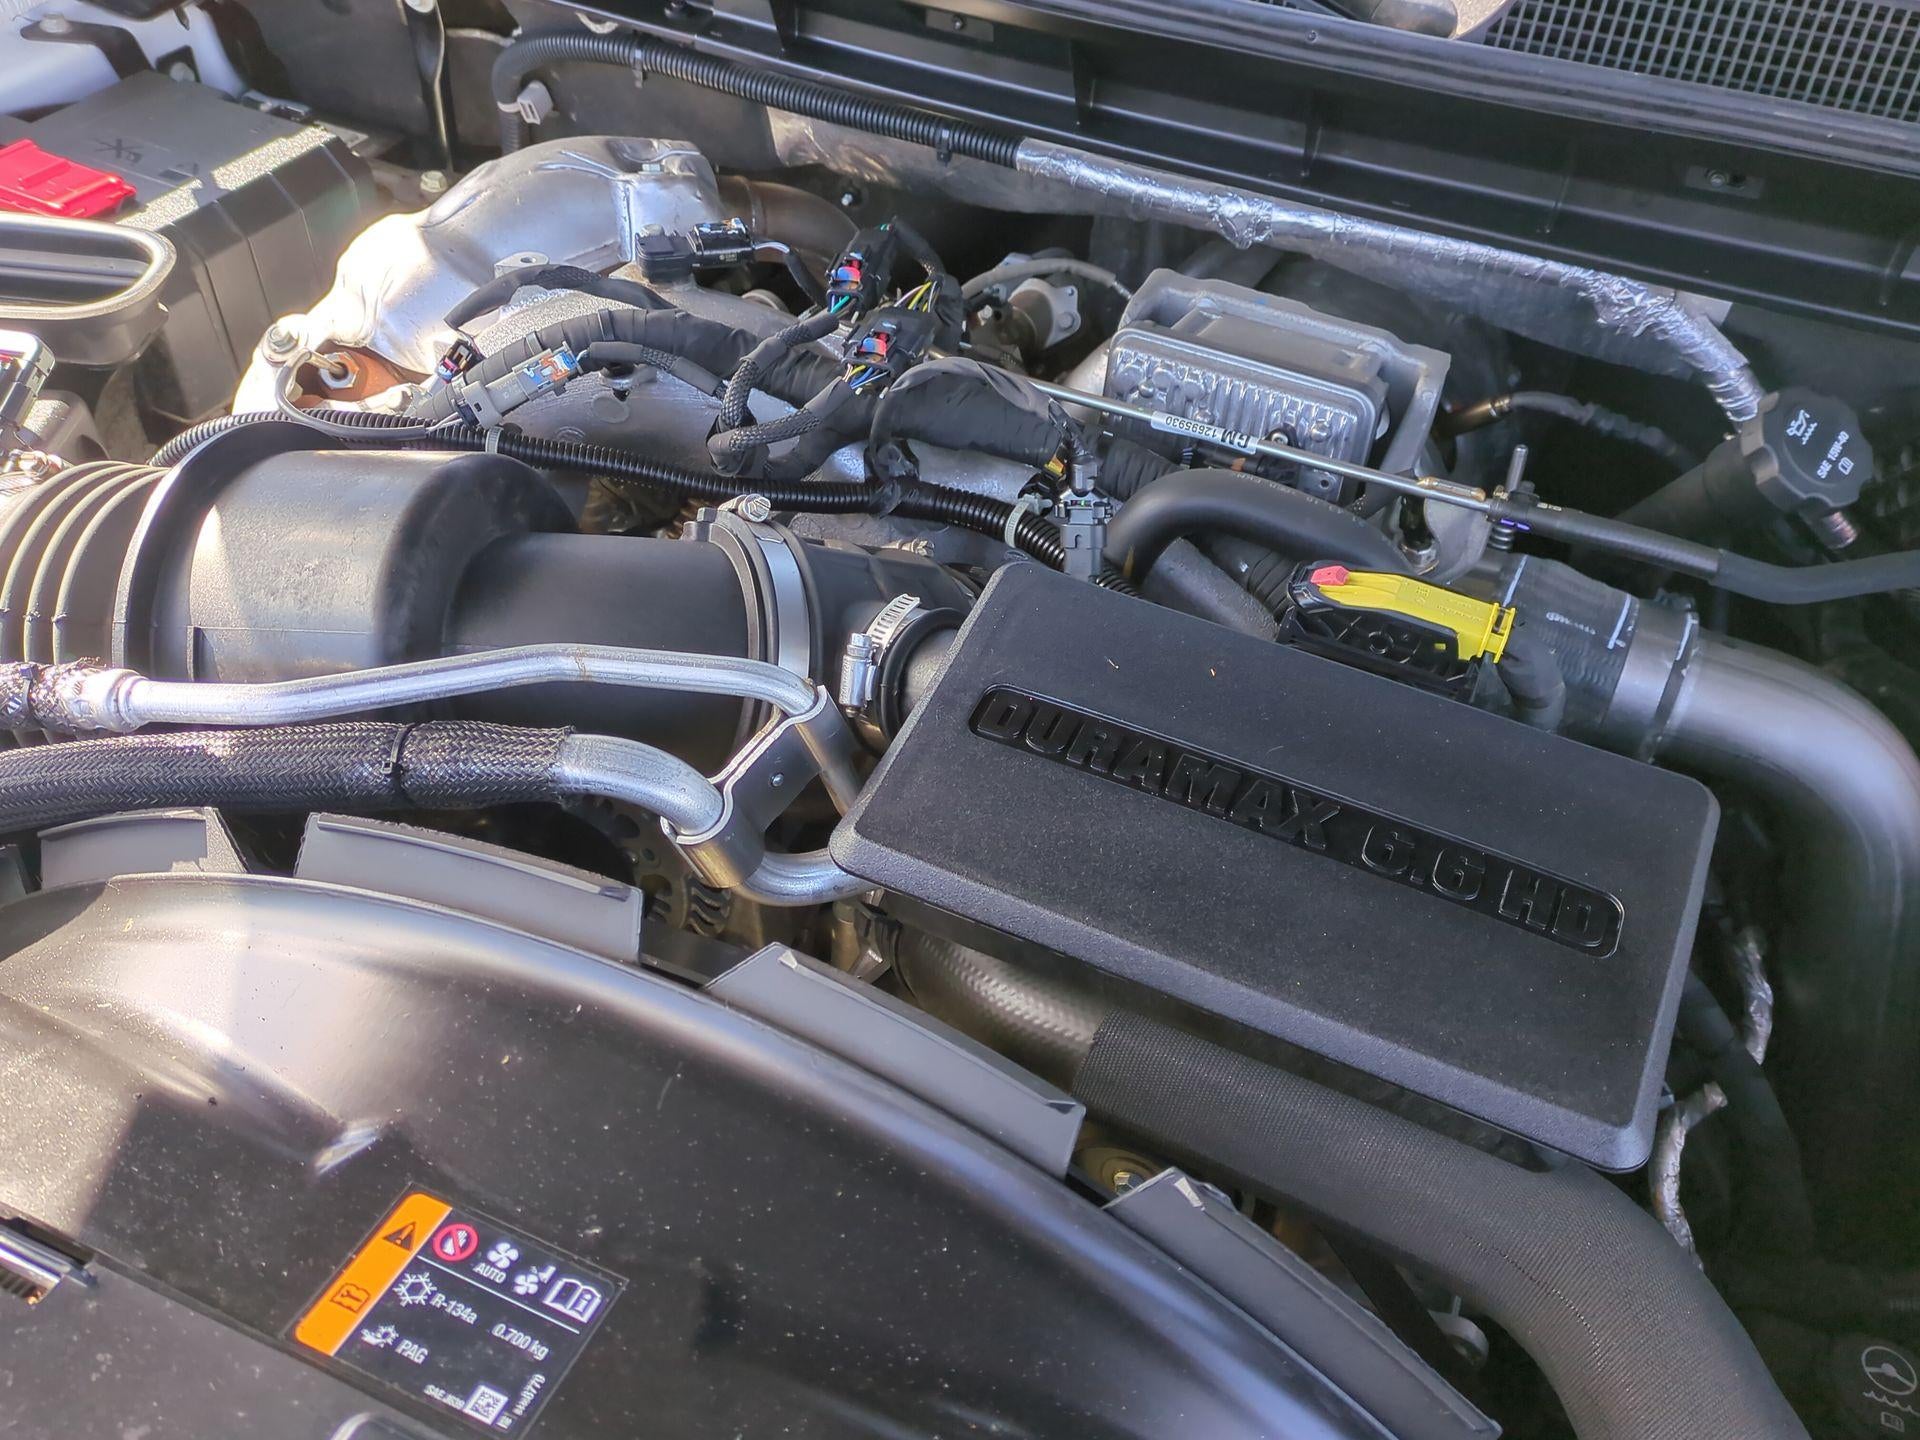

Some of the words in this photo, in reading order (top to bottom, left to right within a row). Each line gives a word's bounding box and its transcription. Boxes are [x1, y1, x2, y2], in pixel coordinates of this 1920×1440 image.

[1165, 415, 1217, 438] 12695930
[1220, 429, 1251, 449] GM
[1816, 460, 1832, 479] SAE
[975, 697, 1341, 850] DURAMAX
[1361, 821, 1487, 902] 6.6
[1498, 869, 1608, 947] HD
[473, 1263, 505, 1283] AUTO
[429, 1292, 478, 1325] R-134a
[491, 1323, 531, 1350] 0.700
[529, 1337, 550, 1361] kg
[396, 1338, 429, 1365] PAG
